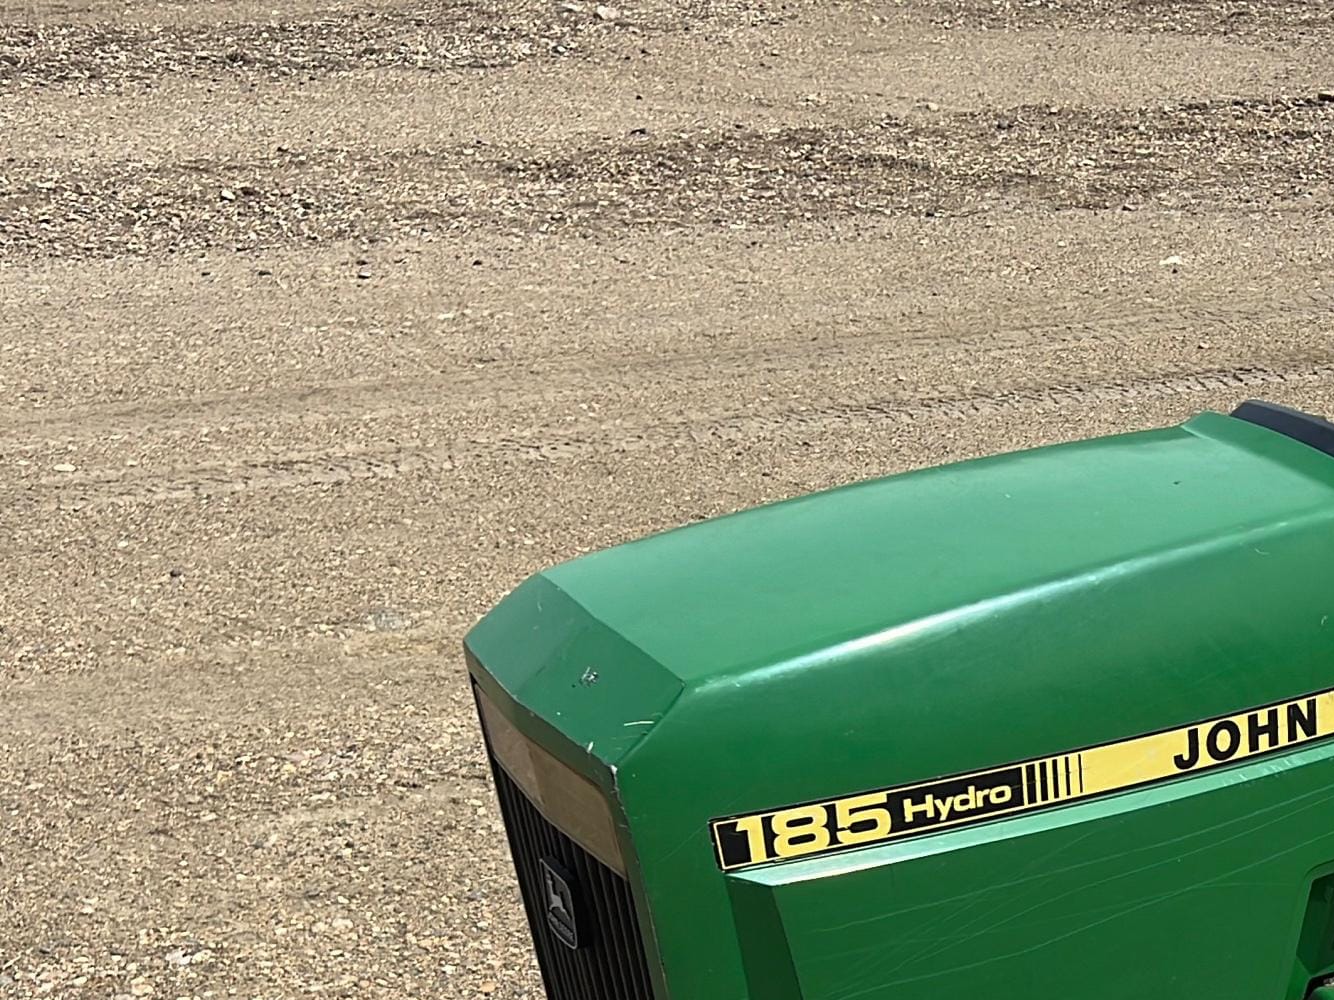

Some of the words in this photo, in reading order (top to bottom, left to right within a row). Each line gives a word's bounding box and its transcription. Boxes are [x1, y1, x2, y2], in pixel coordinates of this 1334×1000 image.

[1173, 698, 1317, 770] JOHN
[736, 793, 892, 863] 185
[903, 785, 1012, 823] Hydro
